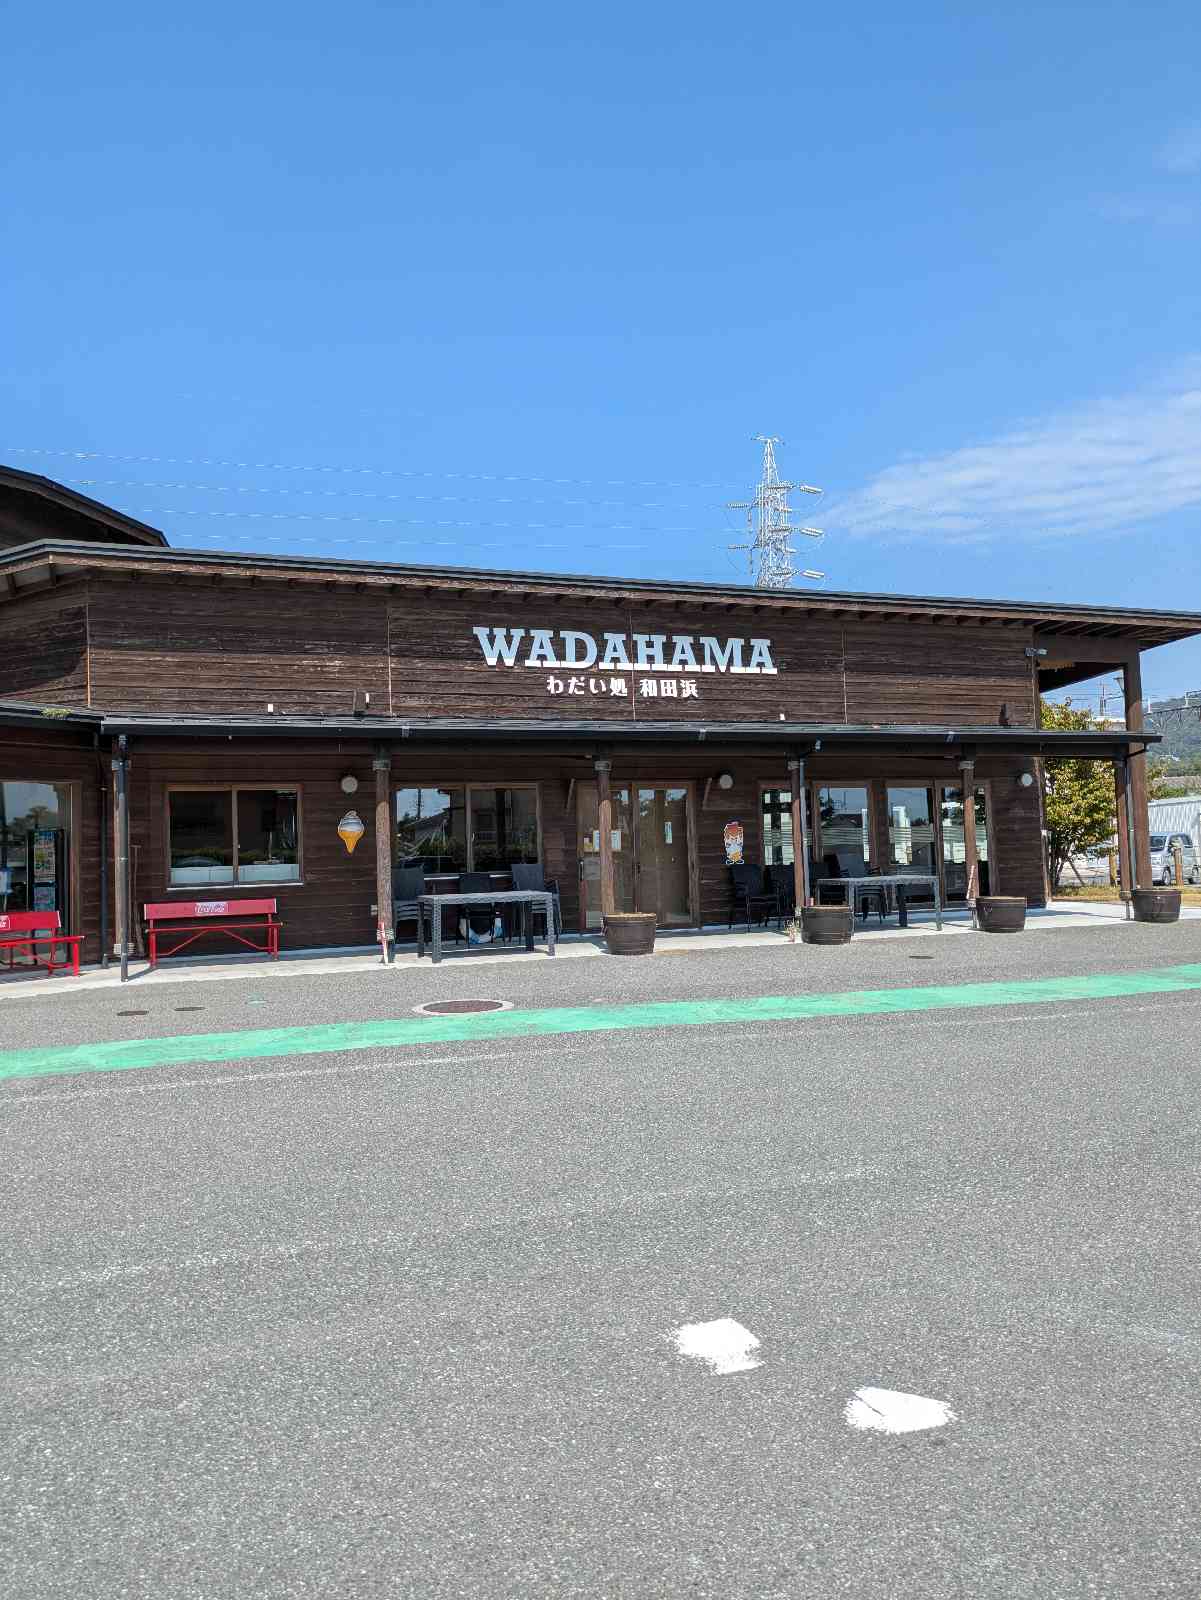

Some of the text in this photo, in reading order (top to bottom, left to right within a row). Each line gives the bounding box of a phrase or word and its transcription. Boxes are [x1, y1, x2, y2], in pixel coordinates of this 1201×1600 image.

[472, 626, 778, 675] WADAHAMA
[546, 675, 699, 698] わだい処 和田浜
